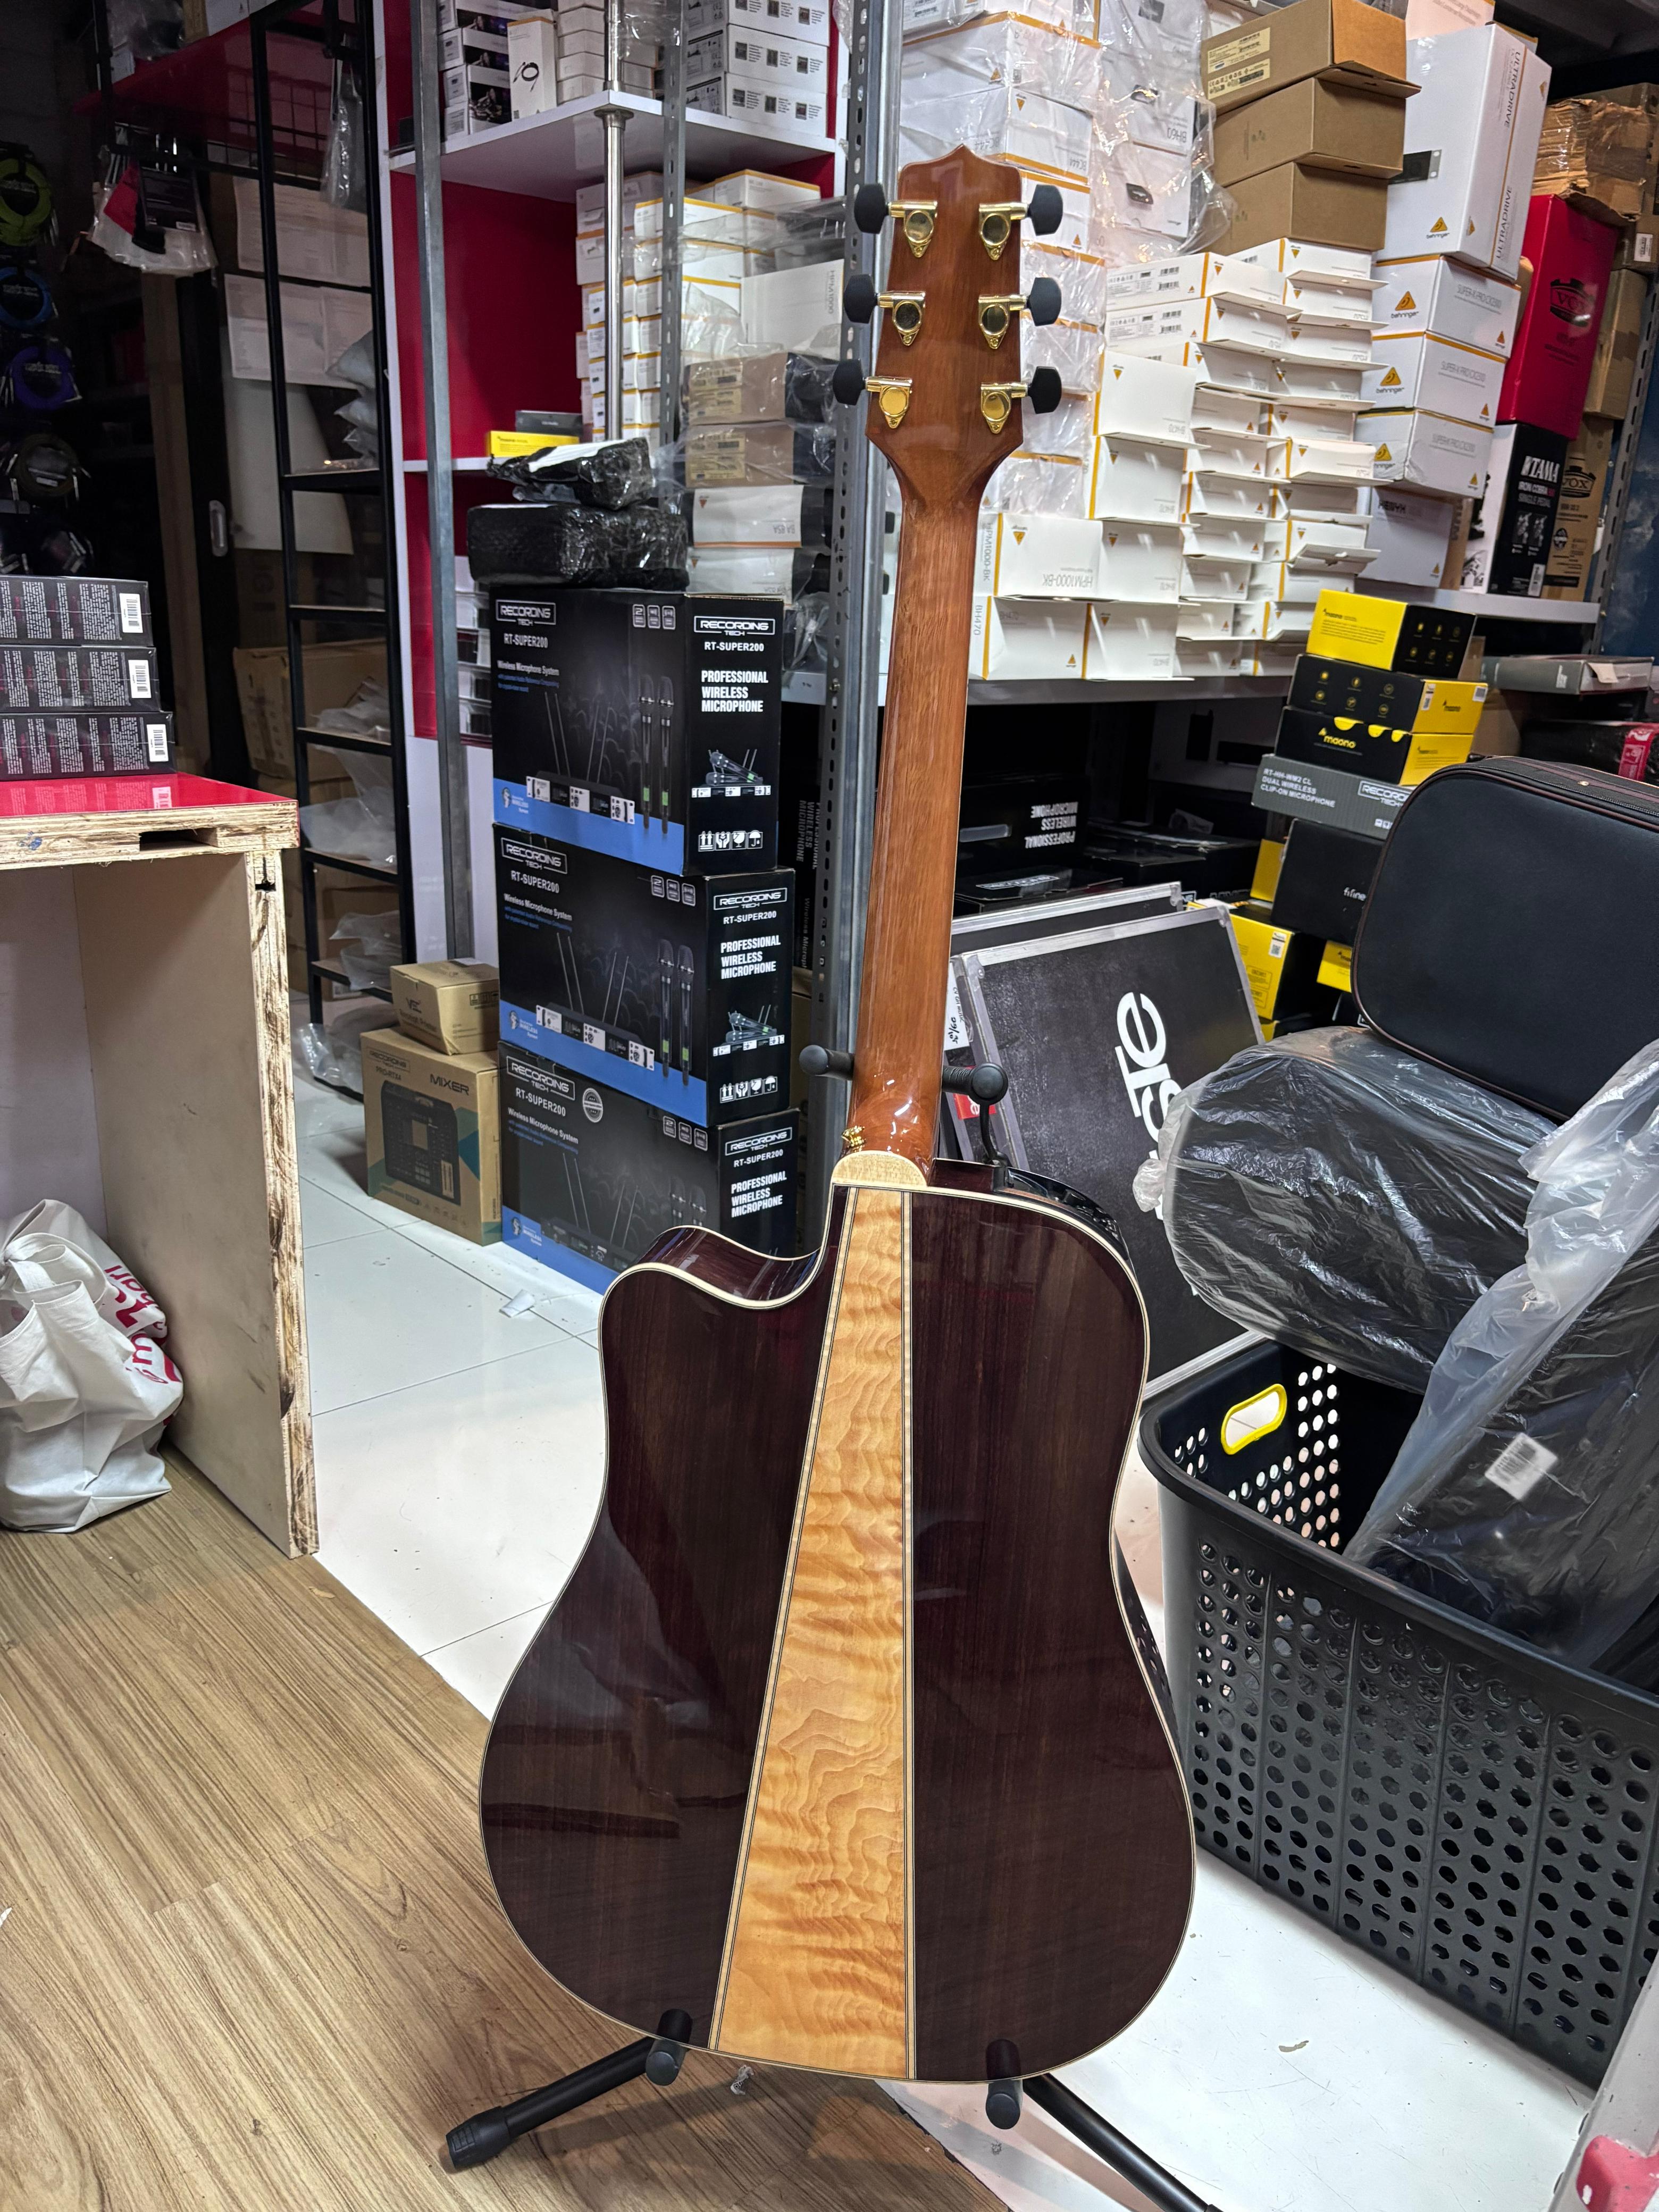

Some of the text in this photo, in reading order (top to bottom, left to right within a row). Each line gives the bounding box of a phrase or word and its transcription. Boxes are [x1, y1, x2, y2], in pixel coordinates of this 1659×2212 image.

[1504, 52, 1520, 128] ULTRADRIVE
[1496, 186, 1512, 259] ULTRADRIVE
[1043, 574, 1093, 588] HPM1000-BK
[500, 605, 551, 618] RECORDING
[700, 620, 769, 631] RECORDING
[504, 633, 549, 648] RT-SUPER200
[705, 641, 764, 651] RT-SUPER200
[701, 671, 768, 683] PROFESSIONAL
[701, 686, 749, 699] WIRELESS
[701, 700, 764, 712] MICROPHONE
[1323, 735, 1356, 749] maono
[1262, 776, 1317, 795] DUAL WIRELESS
[1261, 784, 1336, 808] CLIP-ON MICROPHONE
[1030, 801, 1078, 818] MICROPHONE
[795, 800, 807, 862] MICROPHONE
[805, 801, 815, 848] WIRELESS
[1041, 815, 1077, 831] WIRELESS
[1024, 831, 1076, 849] PROFESSIONAL
[506, 843, 562, 867] RECORDING
[525, 860, 542, 870] TECH
[510, 870, 559, 893] RT-SUPER200
[504, 893, 524, 907] Wireless
[525, 899, 553, 915] Microphone
[554, 908, 573, 921] System
[719, 892, 782, 906] RECORDING
[723, 910, 777, 924] RT-SUPER200
[720, 935, 781, 953] PROFESSIONAL
[721, 951, 763, 967] WIRELESS
[721, 961, 776, 979] MICROPHONE
[430, 1073, 469, 1096] MIXER
[511, 1062, 569, 1093] RECORDING
[531, 1080, 549, 1092] TECH
[516, 1087, 566, 1117] RT-SUPER200
[508, 1107, 529, 1124] Wireless
[529, 1116, 558, 1135] Microphone
[559, 1129, 579, 1144] System
[730, 1131, 787, 1151] RECORDING
[734, 1149, 783, 1168] RT-SUPER200
[731, 1171, 787, 1194] PROFESSIONAL
[731, 1187, 771, 1206] WIRELESS
[731, 1195, 783, 1218] MICROPHONE
